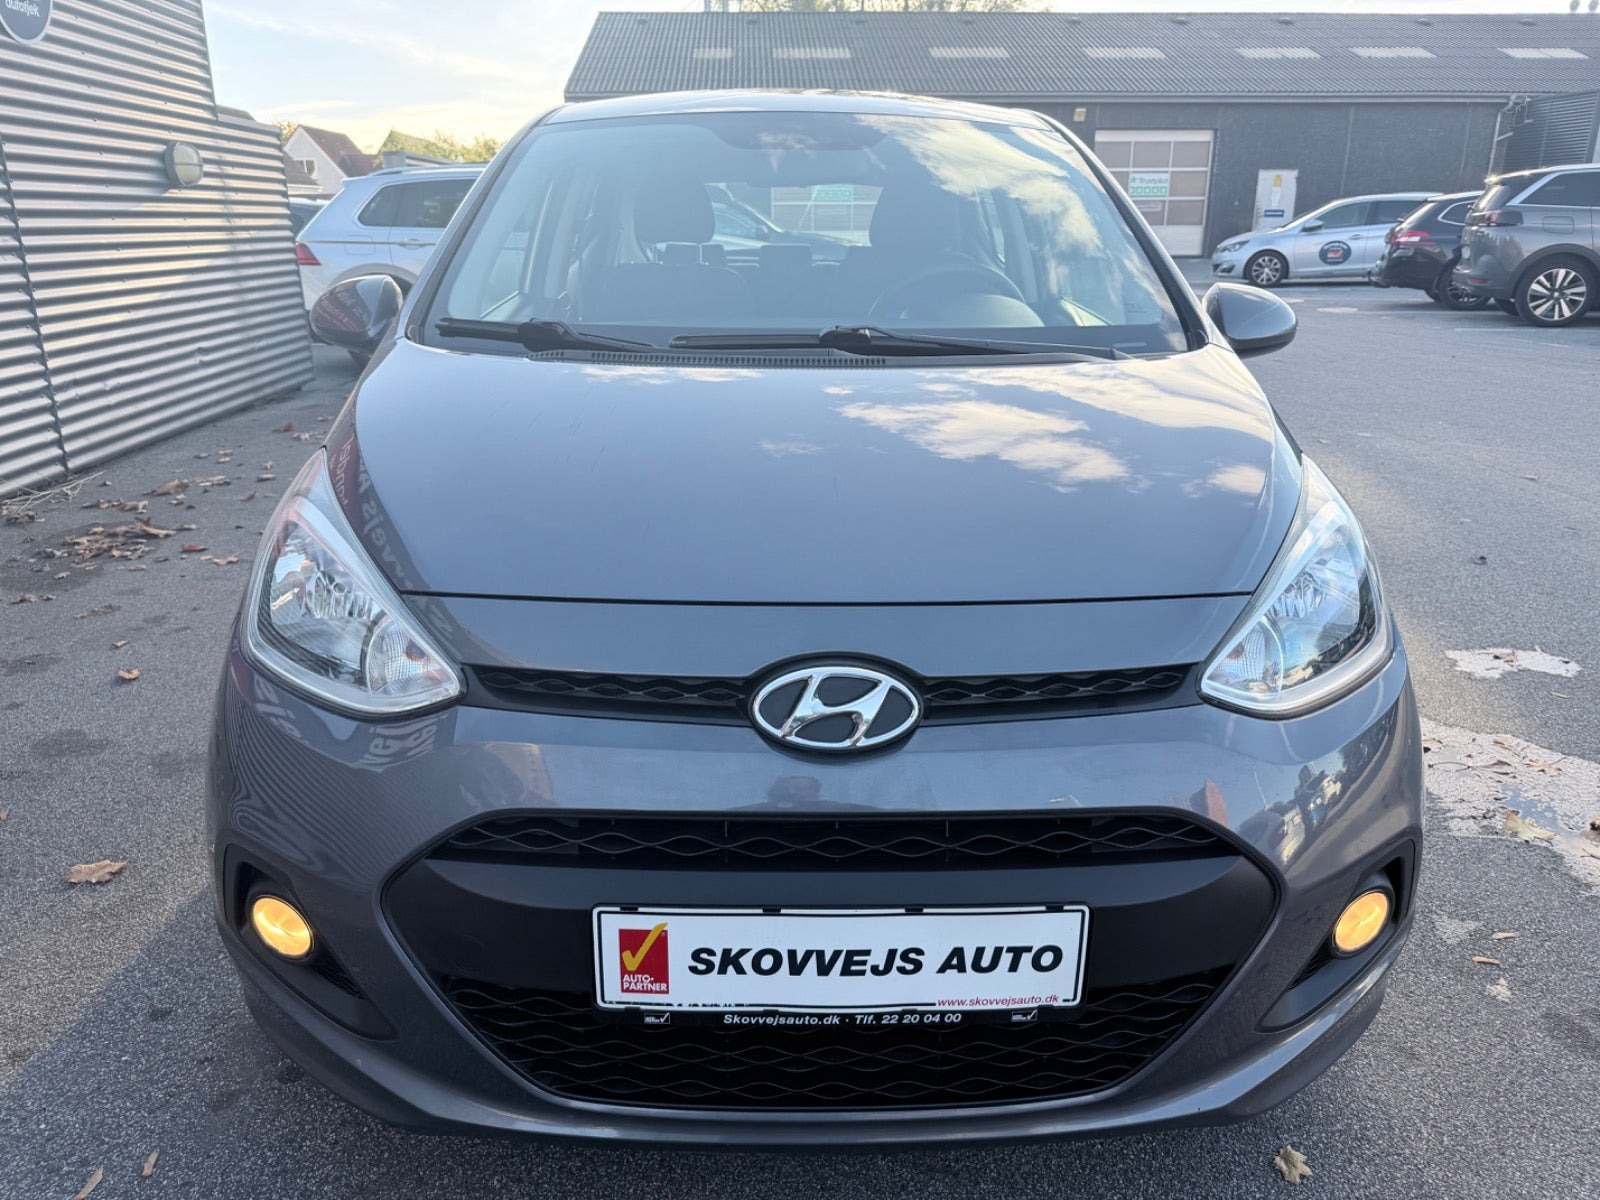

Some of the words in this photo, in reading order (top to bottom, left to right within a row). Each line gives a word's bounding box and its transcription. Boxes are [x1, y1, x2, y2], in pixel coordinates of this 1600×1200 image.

[687, 947, 925, 977] SKOVVEJS
[935, 944, 1064, 974] AUTO
[623, 982, 668, 992] PARTNER
[937, 993, 1060, 1008] www.skovvejsauto.dk
[723, 1013, 841, 1026] Skovvejsauto.dk
[854, 1014, 877, 1025] Tlf.
[881, 1014, 899, 1025] 22
[902, 1014, 921, 1024] 20
[923, 1013, 941, 1024] 04
[944, 1013, 962, 1023] 00
